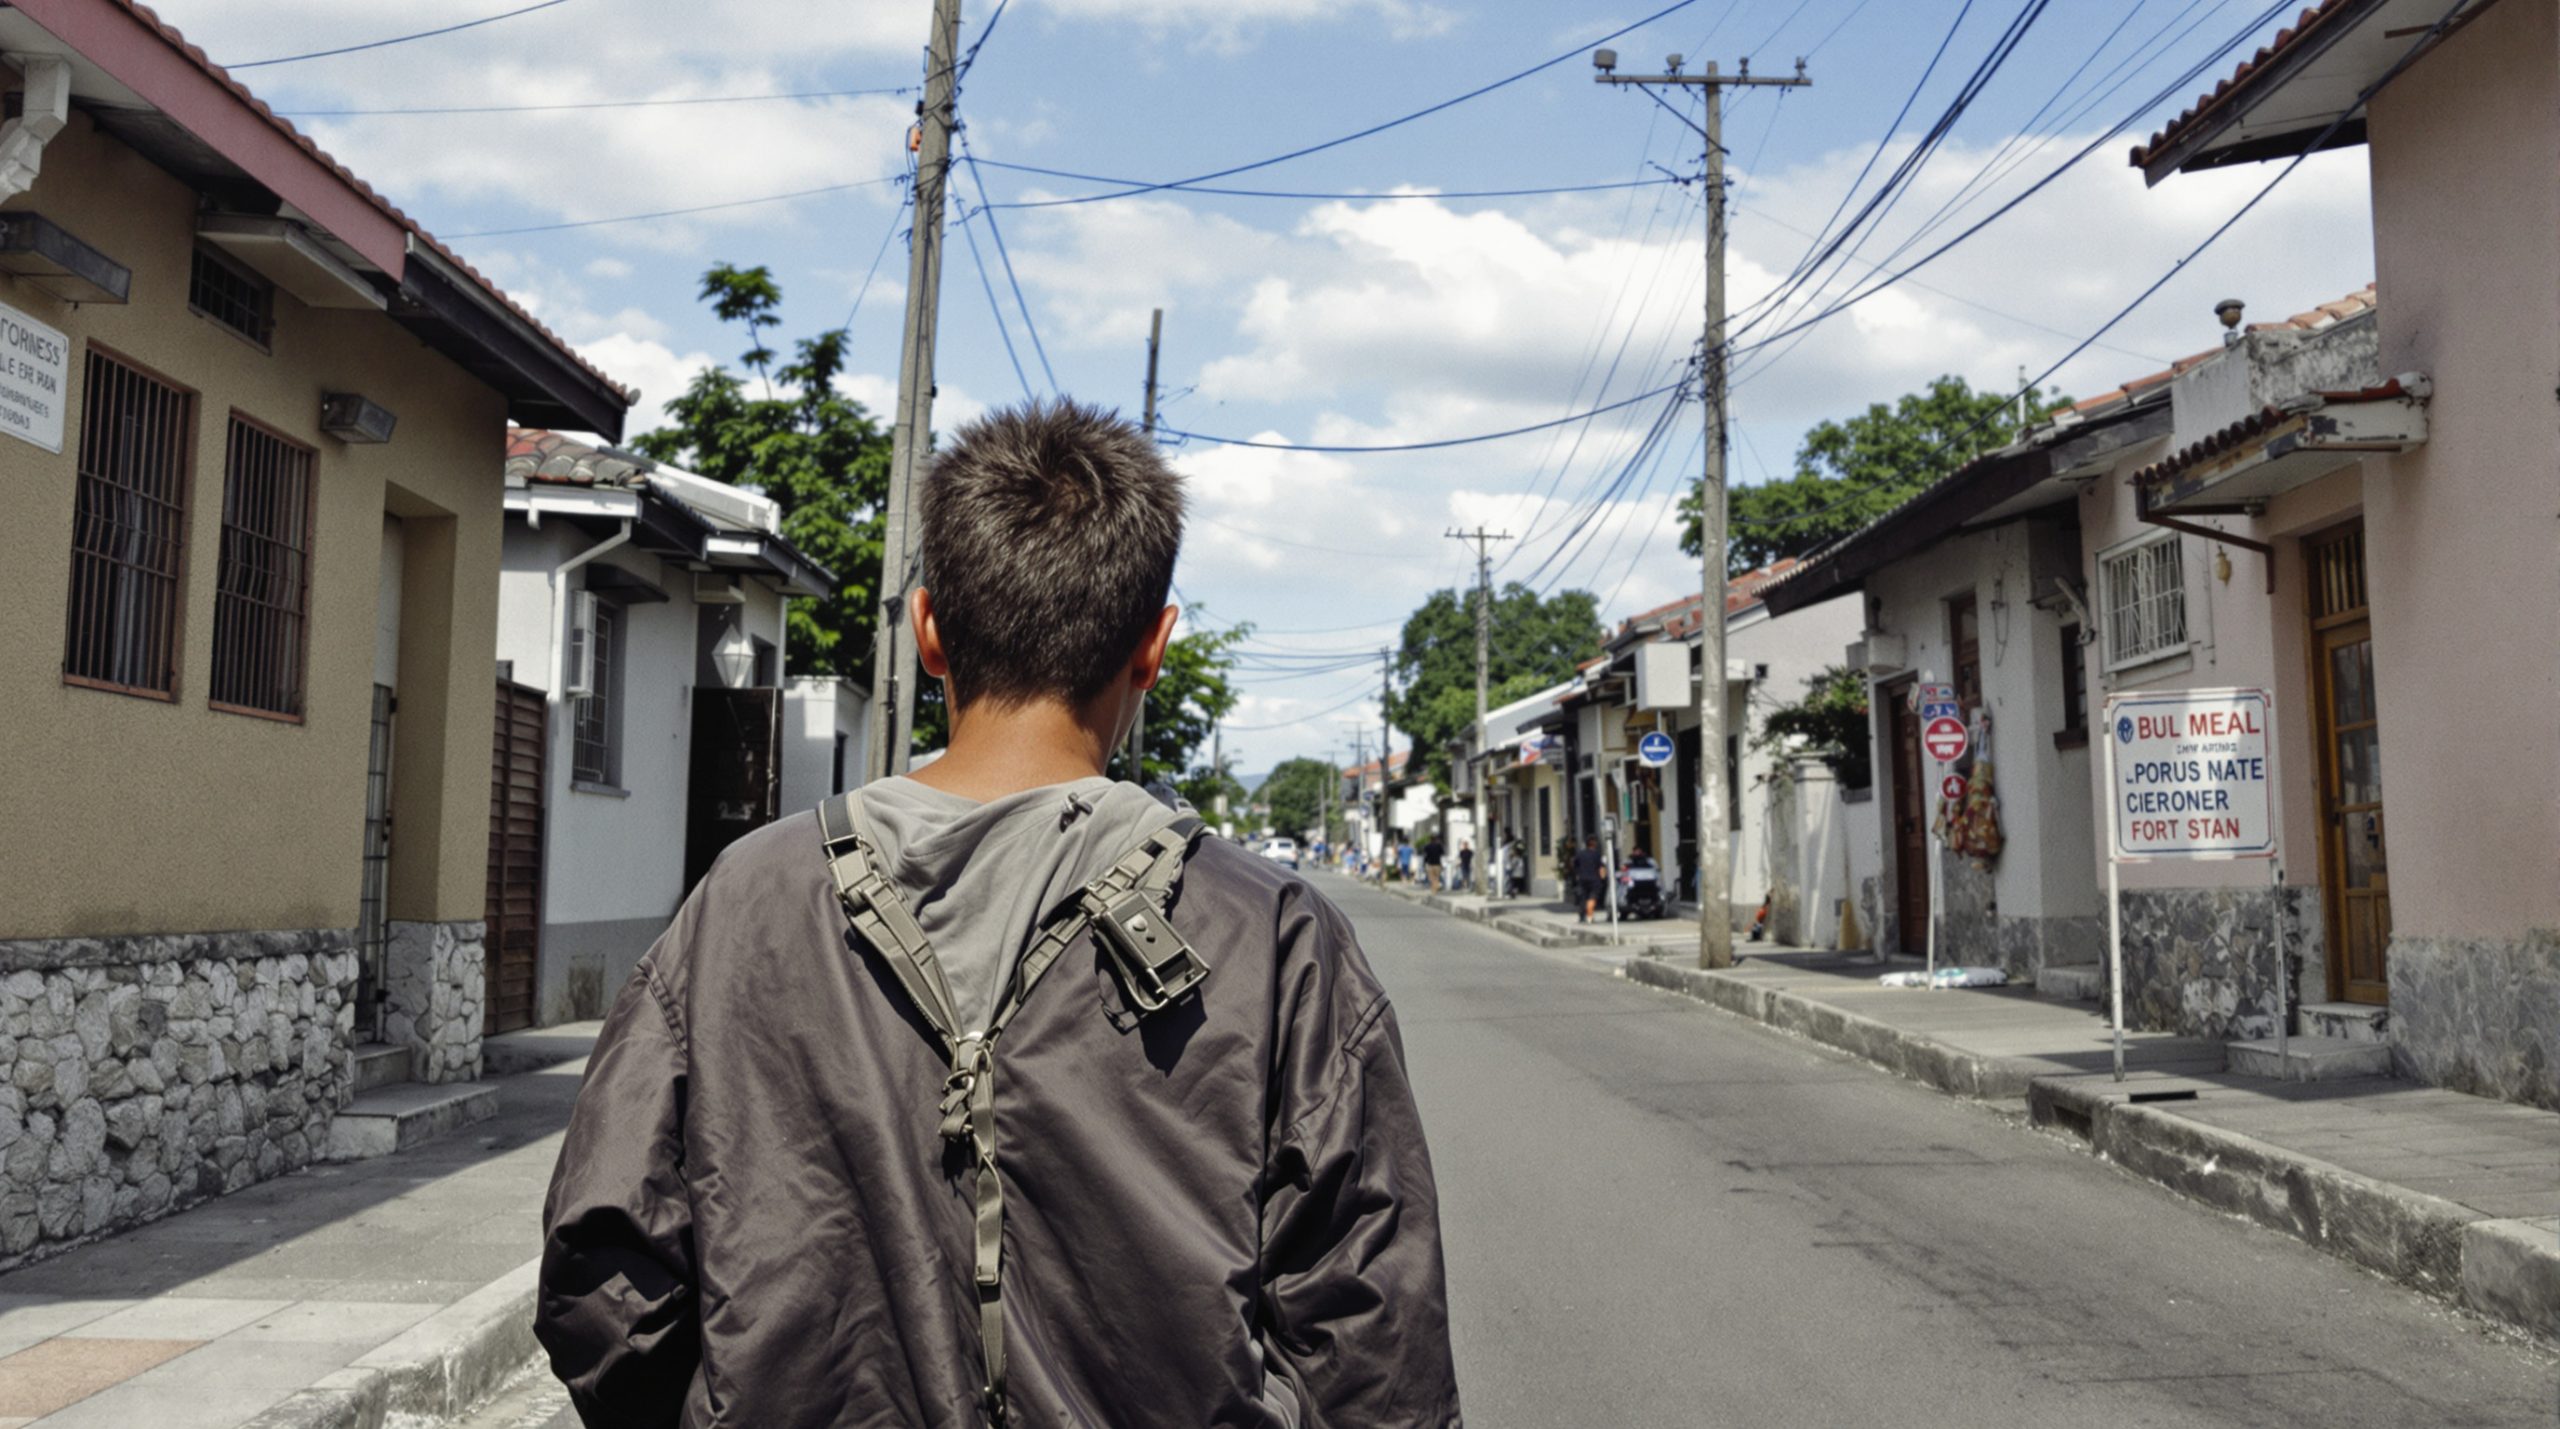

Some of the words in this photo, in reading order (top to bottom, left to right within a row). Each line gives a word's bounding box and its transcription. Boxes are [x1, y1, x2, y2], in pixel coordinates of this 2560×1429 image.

[2137, 715, 2181, 740] BUL
[2189, 711, 2261, 737] MEAL
[2207, 758, 2265, 782] NATE
[2126, 789, 2230, 814] CIERONER
[2131, 819, 2179, 841] FORT
[2187, 817, 2241, 840] STAN
